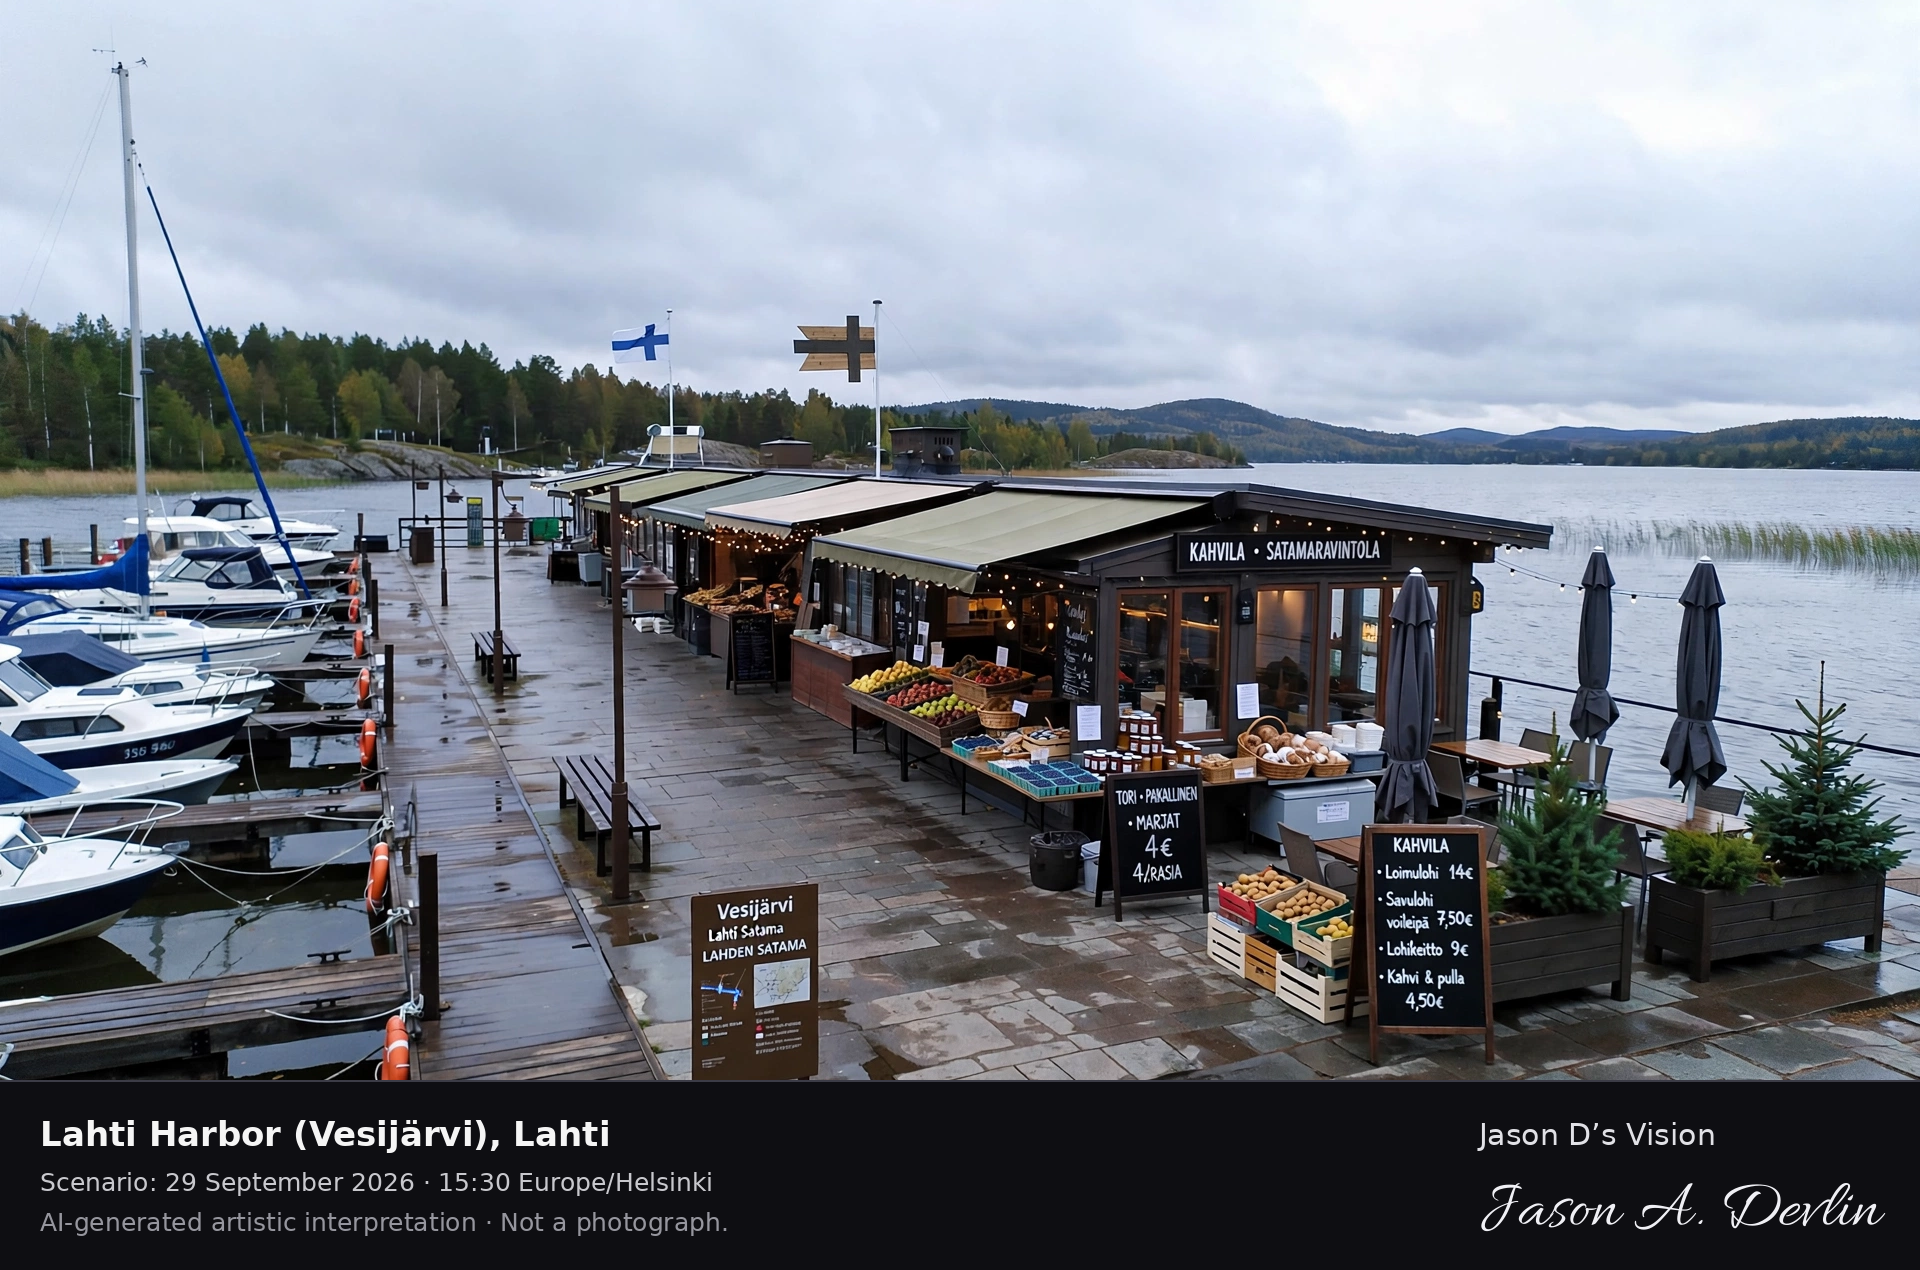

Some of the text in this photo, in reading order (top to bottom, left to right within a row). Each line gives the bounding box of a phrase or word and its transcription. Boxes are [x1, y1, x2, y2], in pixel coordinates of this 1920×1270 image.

[1189, 540, 1381, 562] KAHVILA SATAMARAVINTOLA
[1115, 786, 1198, 806] TORI PAKALLINEN
[1136, 812, 1181, 831] MARJAT
[1393, 836, 1450, 854] KAHVILA
[1385, 863, 1474, 880] Loimulohi 14€
[717, 895, 793, 921] Vesijärvi
[1386, 890, 1434, 907] Savulohi
[1436, 910, 1474, 930] 7,50€
[708, 923, 785, 942] Lahti Satama
[702, 938, 808, 963] LAHDEN SATAMA
[1386, 939, 1469, 957] Lohikeitto 9€
[1387, 967, 1465, 990] Kahvi & pulla
[1405, 992, 1444, 1012] 4,50€
